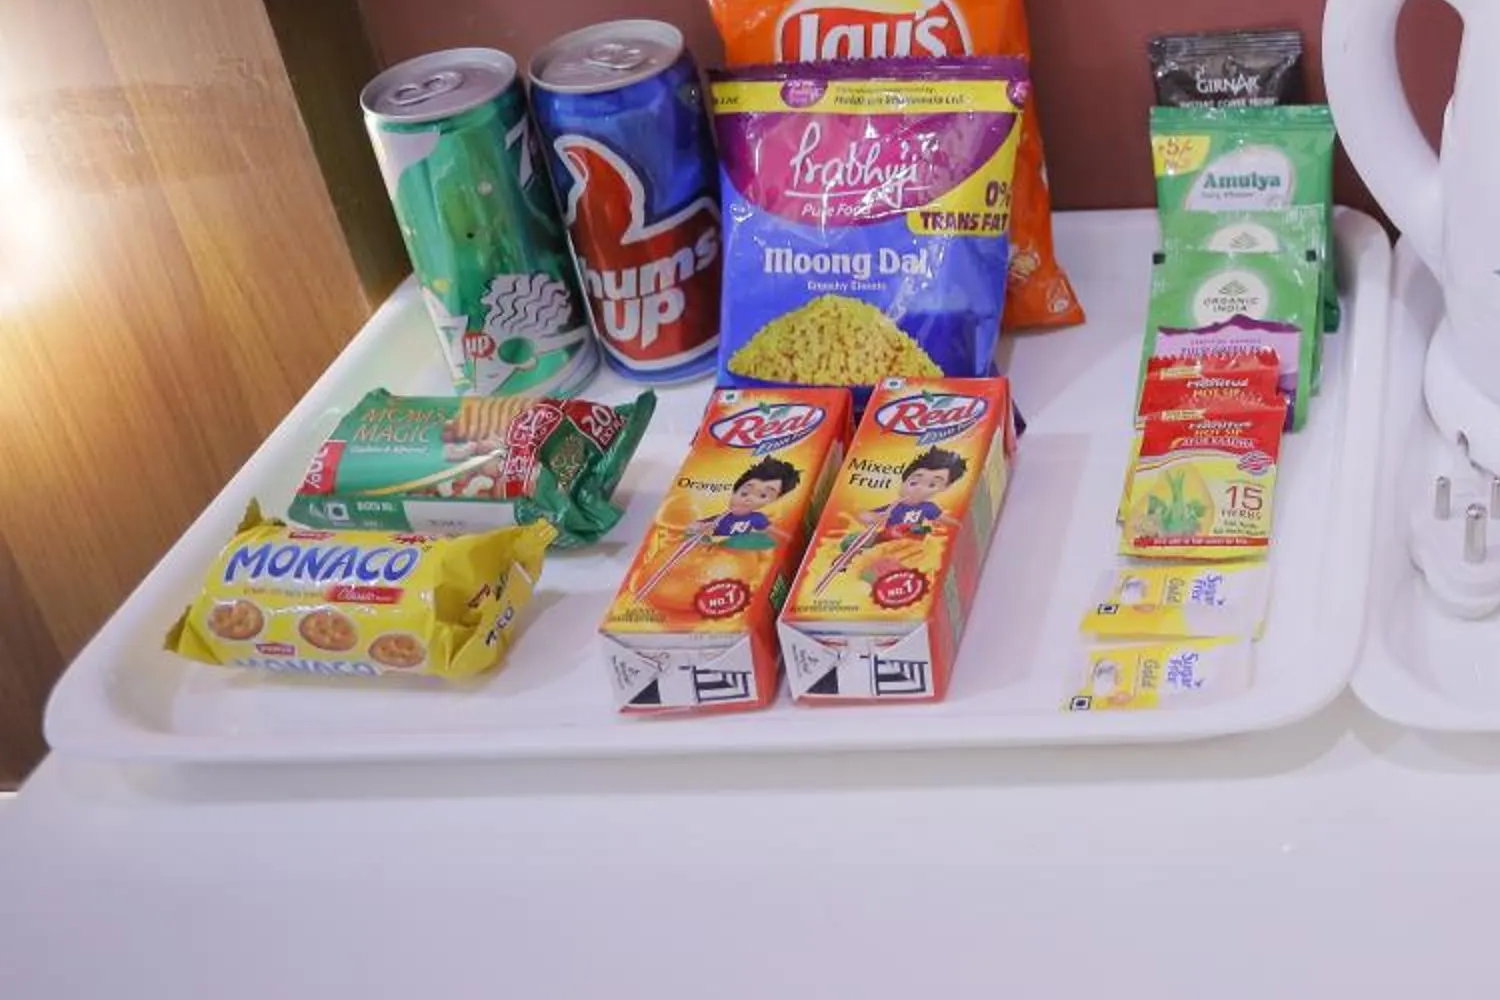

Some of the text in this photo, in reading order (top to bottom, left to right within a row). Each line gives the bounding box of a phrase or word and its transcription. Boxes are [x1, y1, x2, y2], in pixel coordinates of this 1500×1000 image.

[1203, 172, 1281, 190] Amulya
[920, 211, 1009, 232] TRANS FAT
[578, 229, 719, 301] hums
[764, 247, 928, 280] Moong Dal
[1203, 297, 1261, 307] ORGANIC
[1213, 305, 1247, 313] INDIA
[718, 406, 819, 445] Real
[880, 398, 981, 434] Real
[847, 457, 905, 476] Mixed
[677, 476, 733, 493] Orange
[848, 473, 892, 489] Fruit
[1225, 485, 1264, 511] 15
[224, 541, 420, 583] MONACO
[1181, 652, 1199, 687] Sugar
